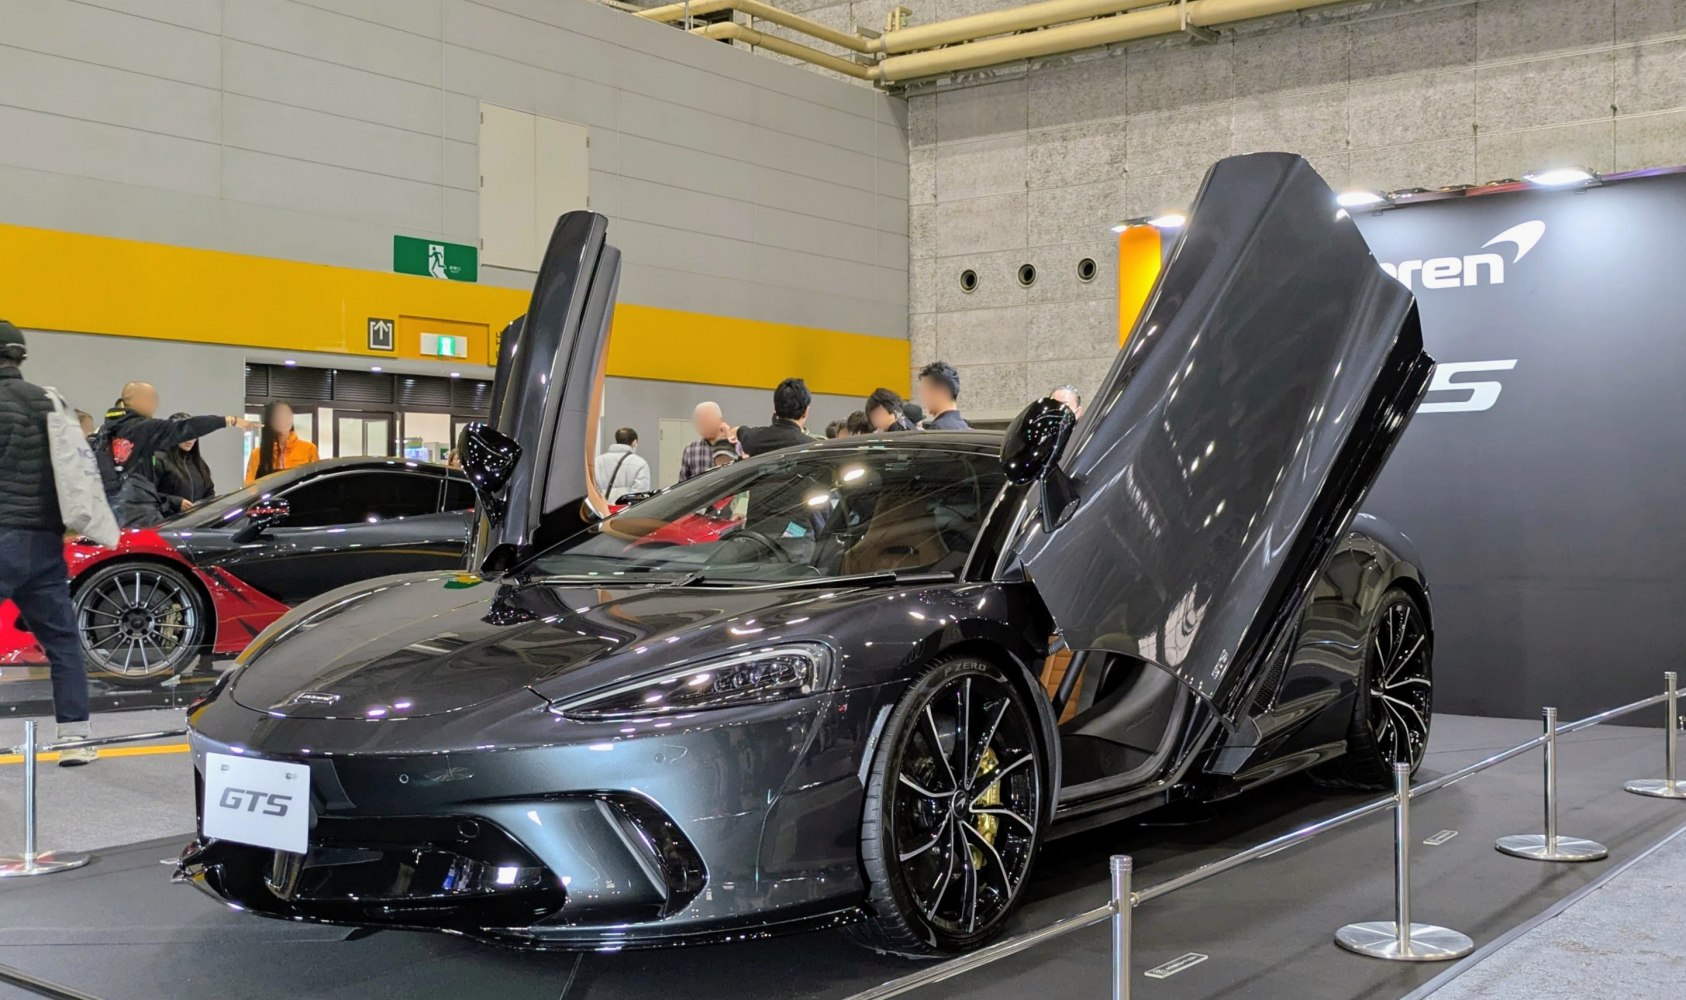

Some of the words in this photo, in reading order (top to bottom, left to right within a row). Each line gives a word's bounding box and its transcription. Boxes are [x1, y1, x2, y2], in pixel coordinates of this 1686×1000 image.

[944, 666, 952, 677] P
[954, 662, 987, 672] ZERO
[219, 786, 293, 817] GTS
